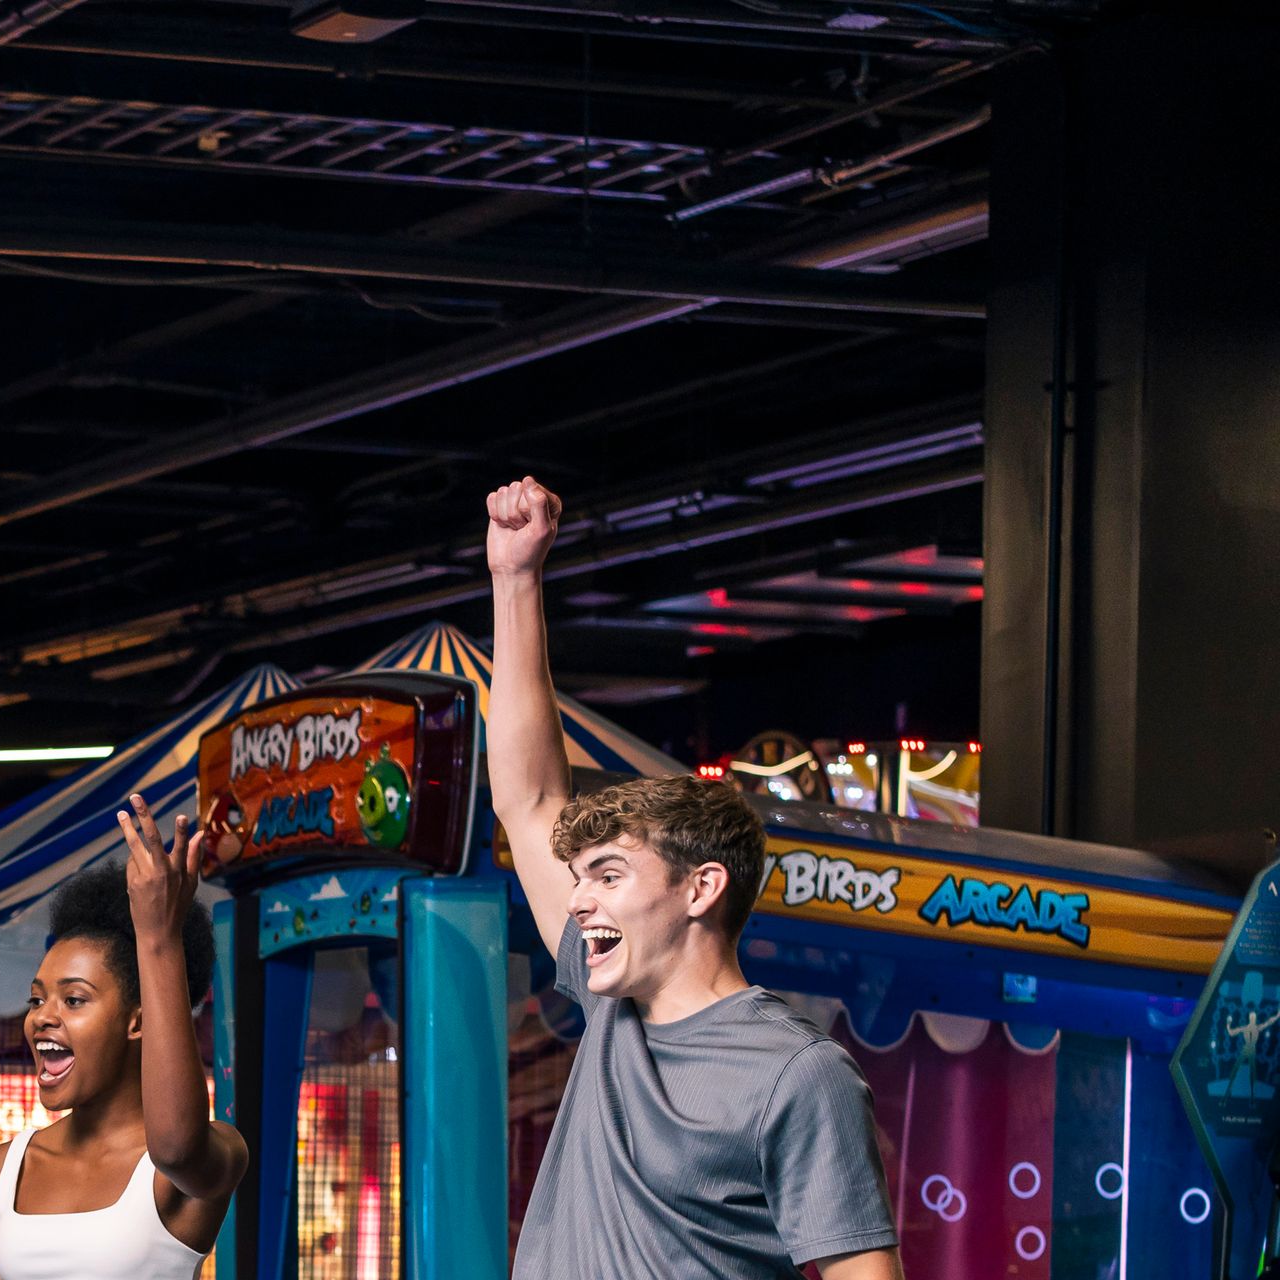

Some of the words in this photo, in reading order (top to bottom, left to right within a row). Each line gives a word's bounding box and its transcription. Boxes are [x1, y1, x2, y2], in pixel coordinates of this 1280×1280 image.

[230, 724, 293, 780] ANGRY
[296, 709, 361, 771] BIRDS
[253, 787, 334, 846] ARCADE
[780, 851, 900, 913] BIRDS
[919, 874, 1089, 947] ARCADE
